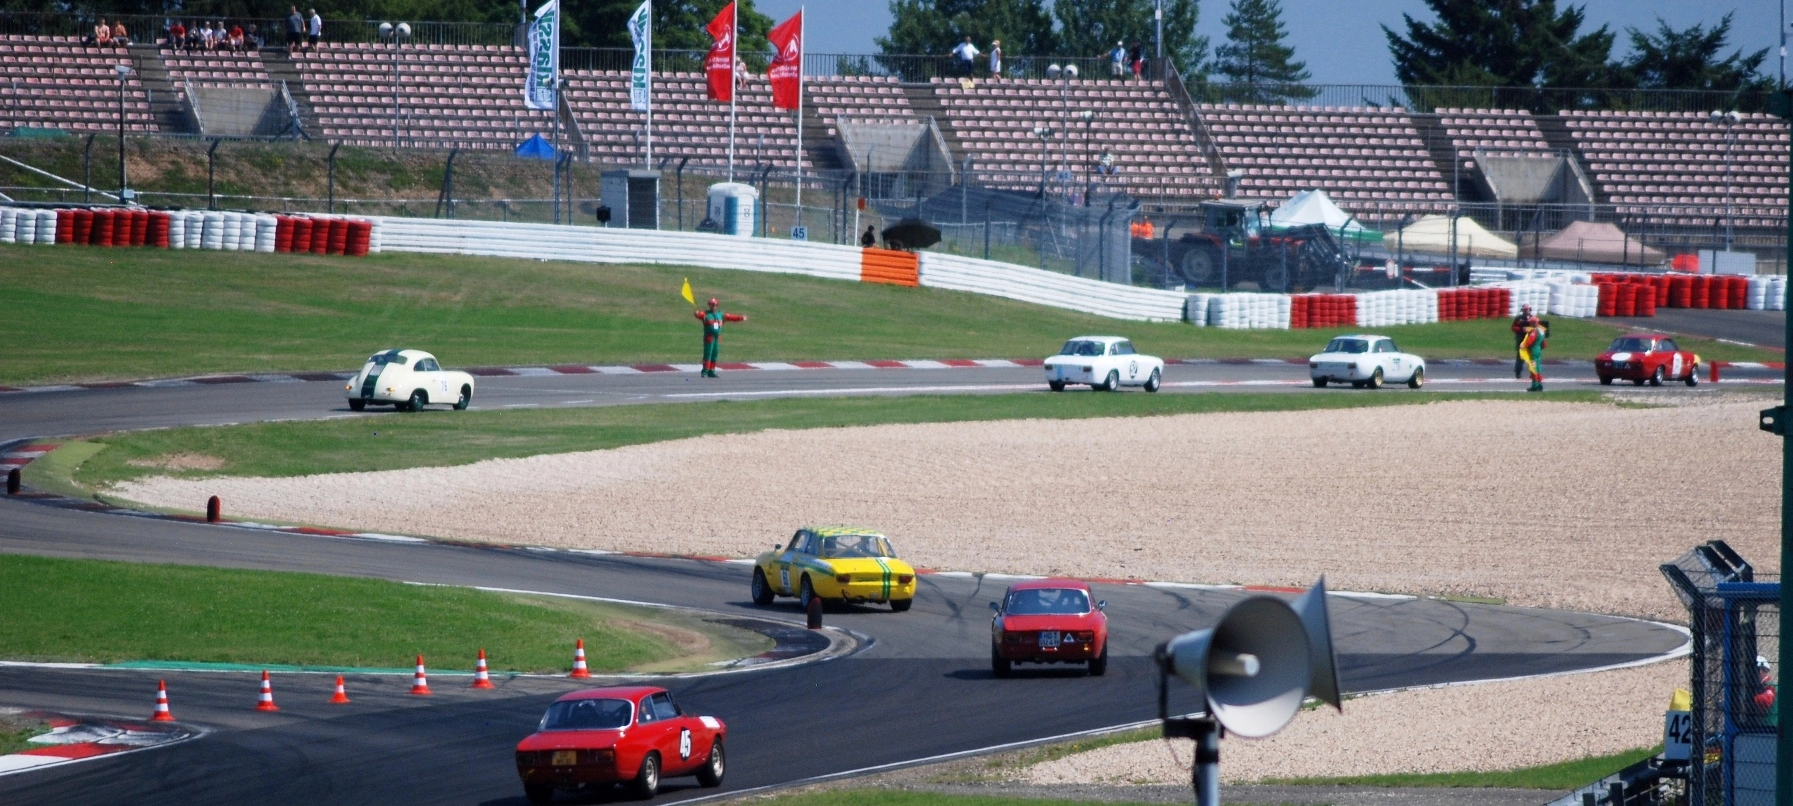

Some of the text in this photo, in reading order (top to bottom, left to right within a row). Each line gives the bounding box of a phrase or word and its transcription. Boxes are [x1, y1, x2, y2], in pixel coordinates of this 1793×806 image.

[792, 227, 805, 239] 45
[680, 729, 691, 758] 45
[1668, 714, 1691, 744] 42
